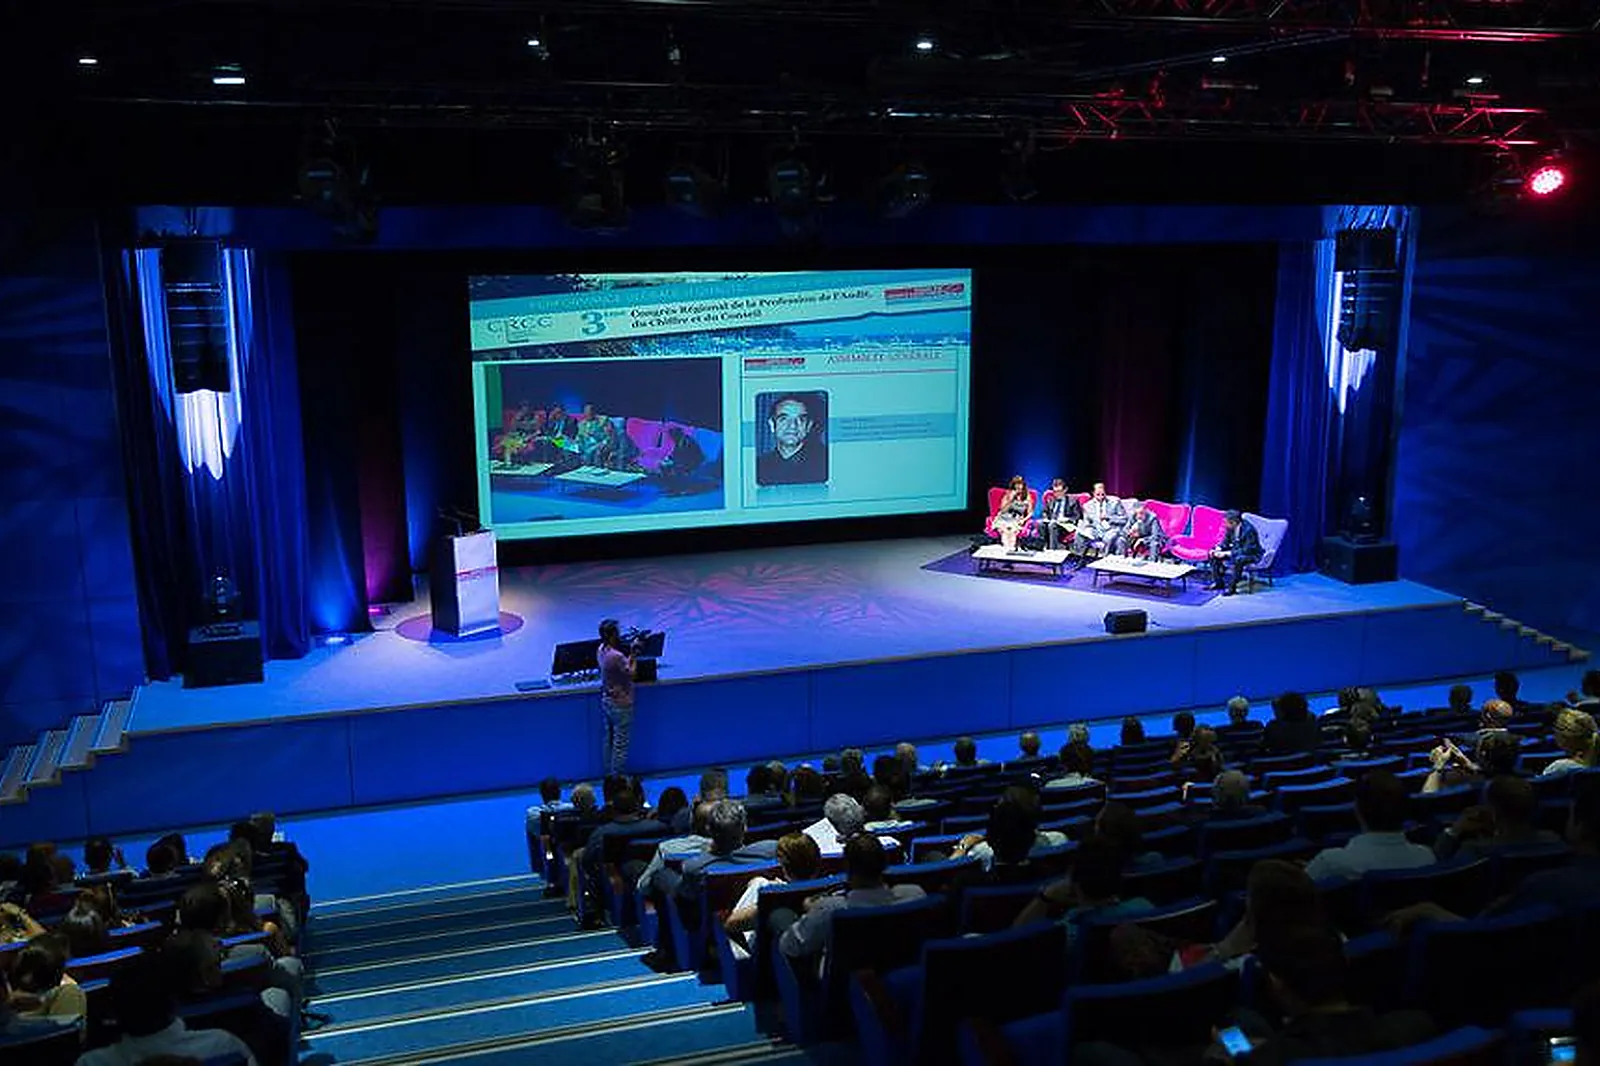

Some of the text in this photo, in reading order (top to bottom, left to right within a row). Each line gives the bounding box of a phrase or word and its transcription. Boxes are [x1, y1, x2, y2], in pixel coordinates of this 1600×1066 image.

[631, 306, 678, 320] Congrès
[680, 300, 727, 315] Régional
[731, 299, 745, 310] de
[746, 298, 757, 308] la
[759, 292, 816, 308] Profession
[820, 290, 832, 301] de
[631, 308, 761, 329] du Chiffre et du Conseil
